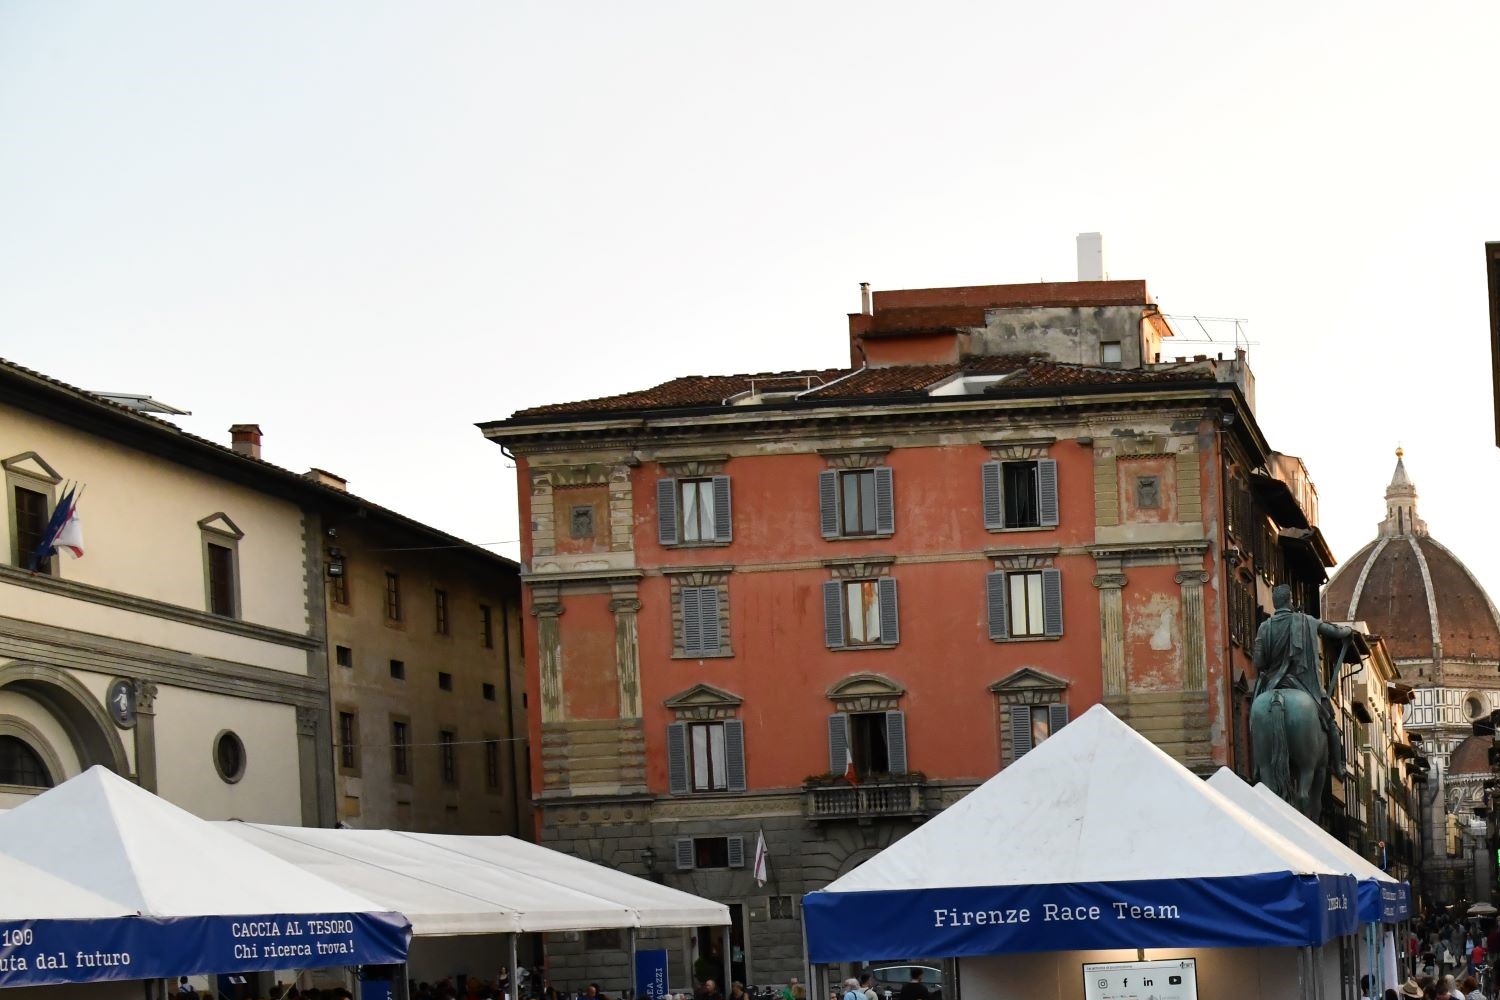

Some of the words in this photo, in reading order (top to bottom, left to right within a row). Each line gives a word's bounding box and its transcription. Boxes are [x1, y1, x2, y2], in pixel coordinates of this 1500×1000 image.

[933, 908, 1031, 927] Firenze
[1043, 903, 1101, 922] Race
[1112, 902, 1181, 920] Team
[2, 928, 33, 947] 100
[231, 922, 281, 938] CACCIA
[285, 921, 303, 936] AL
[307, 919, 354, 935] TESORO
[234, 943, 259, 959] Chi
[263, 942, 312, 958] ricerca
[316, 939, 355, 955] trova!
[36, 952, 69, 970] dal
[75, 950, 131, 968] futuro
[655, 967, 664, 1000] AGAZZI
